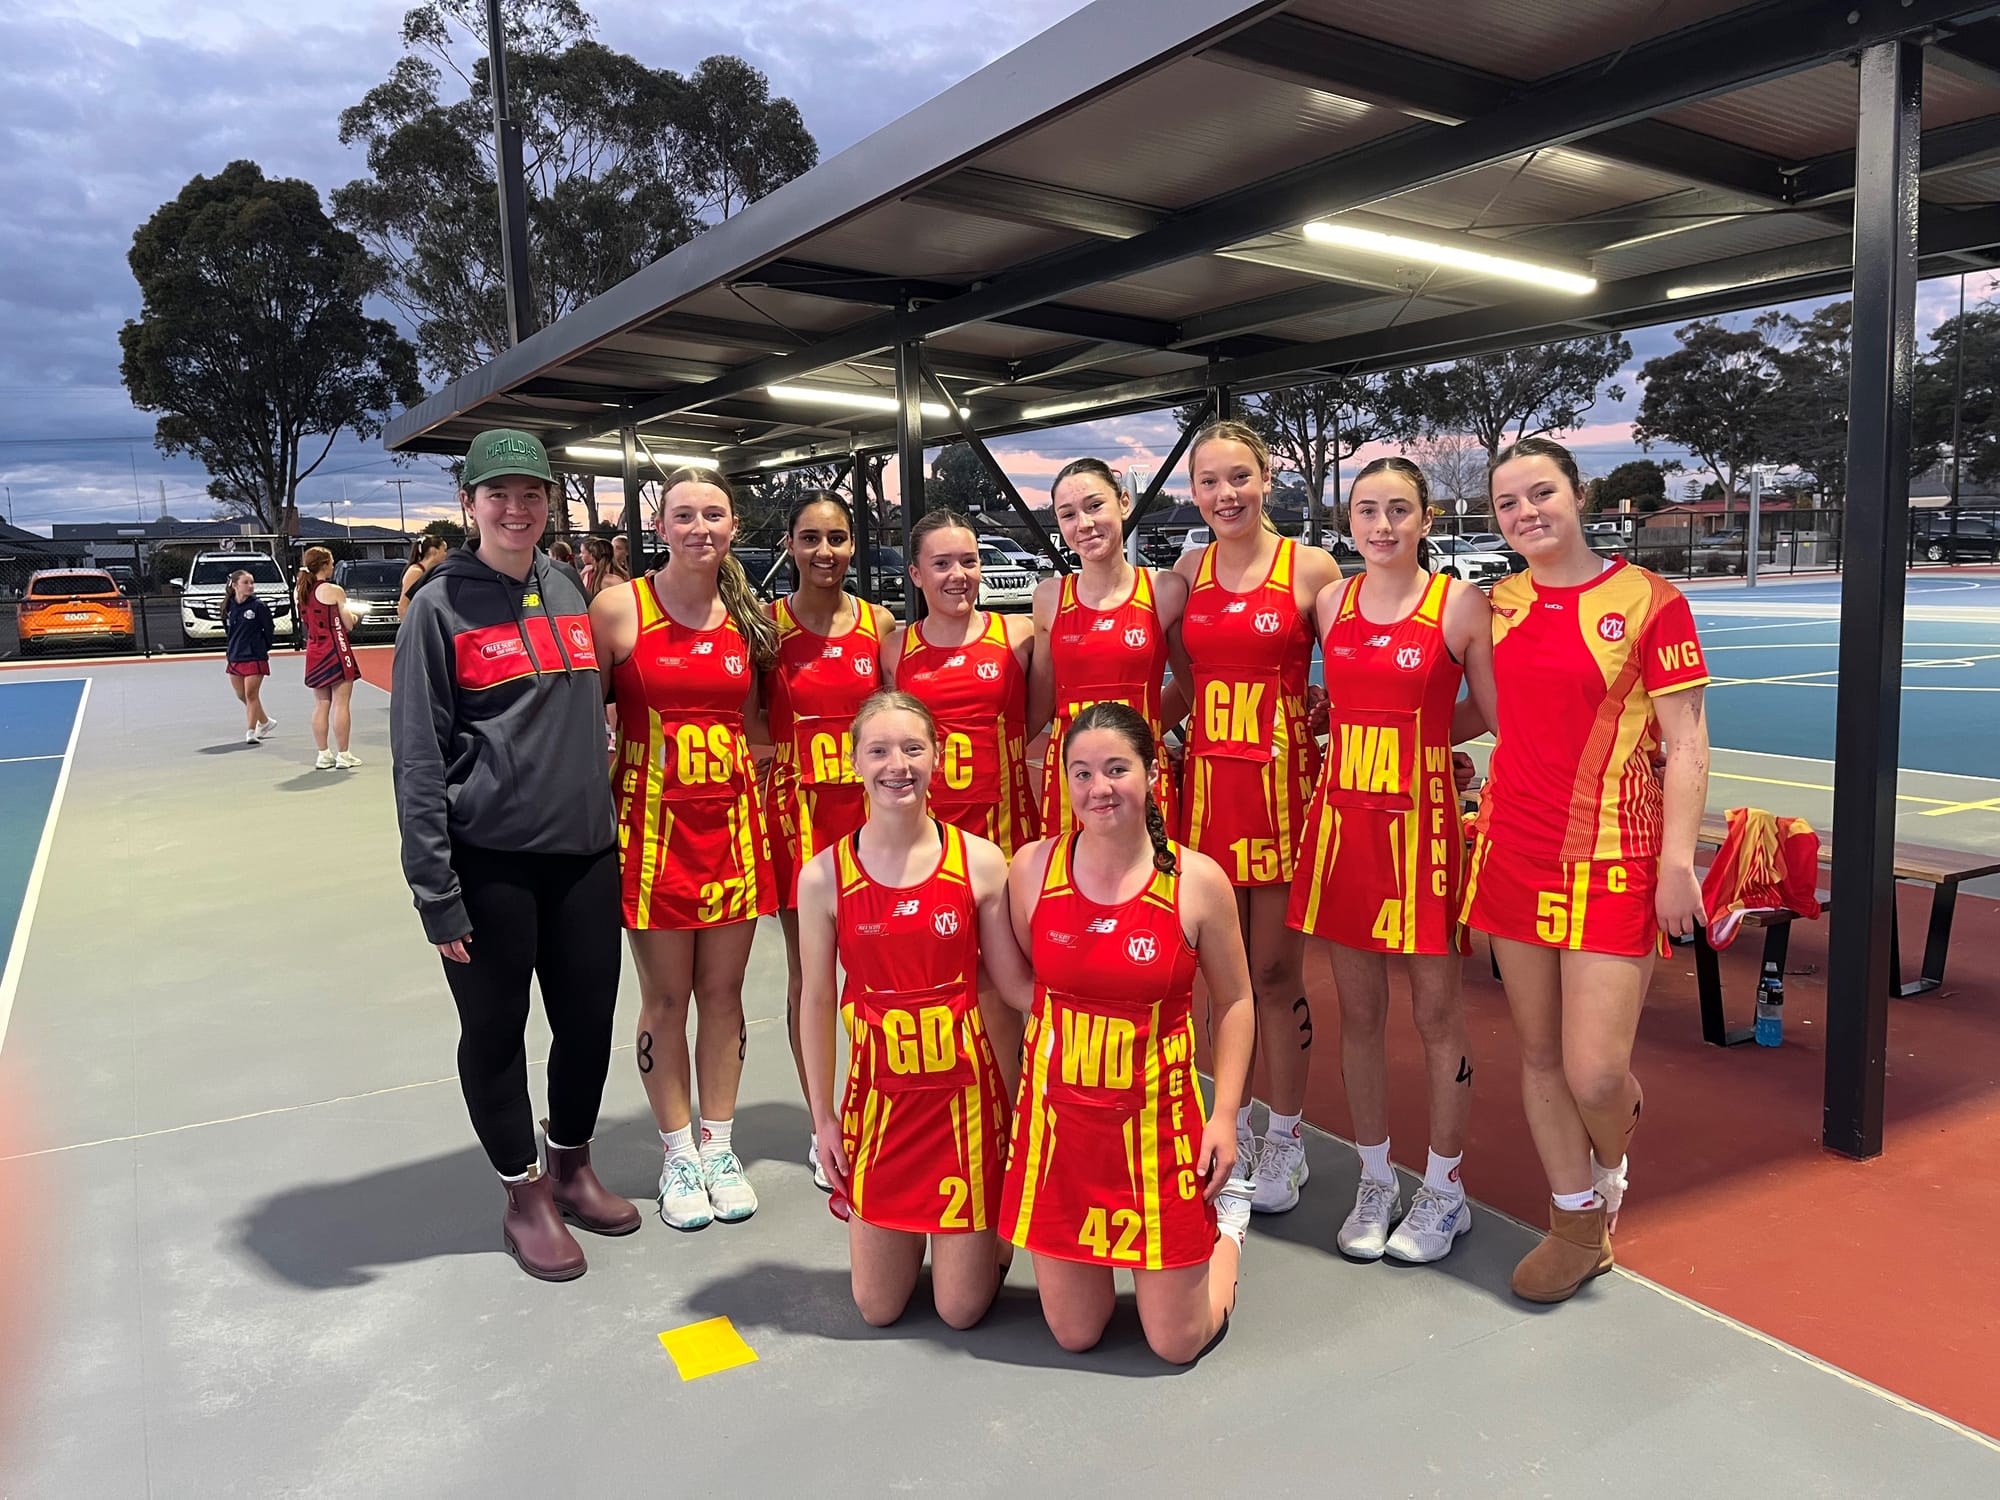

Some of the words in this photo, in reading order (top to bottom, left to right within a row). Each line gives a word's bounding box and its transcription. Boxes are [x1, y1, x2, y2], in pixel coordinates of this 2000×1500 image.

[1052, 535, 1058, 545] 7
[1657, 641, 1700, 672] WG
[1205, 680, 1266, 744] GK
[676, 723, 733, 785] GS
[944, 732, 973, 790] C
[1339, 724, 1400, 794] WA
[1425, 746, 1447, 897] WGFNC
[1229, 837, 1278, 882] 15
[1606, 865, 1628, 893] C
[697, 877, 746, 923] 37
[1371, 899, 1402, 949] 4
[1536, 891, 1568, 943] 5
[882, 1005, 957, 1076] GD
[1061, 1008, 1136, 1090] WD
[1292, 997, 1313, 1050] 3
[637, 1031, 654, 1073] 8
[1455, 1056, 1474, 1088] 4
[1162, 1032, 1197, 1200] WGFNC
[939, 1176, 969, 1229] 2
[1078, 1207, 1142, 1262] 42
